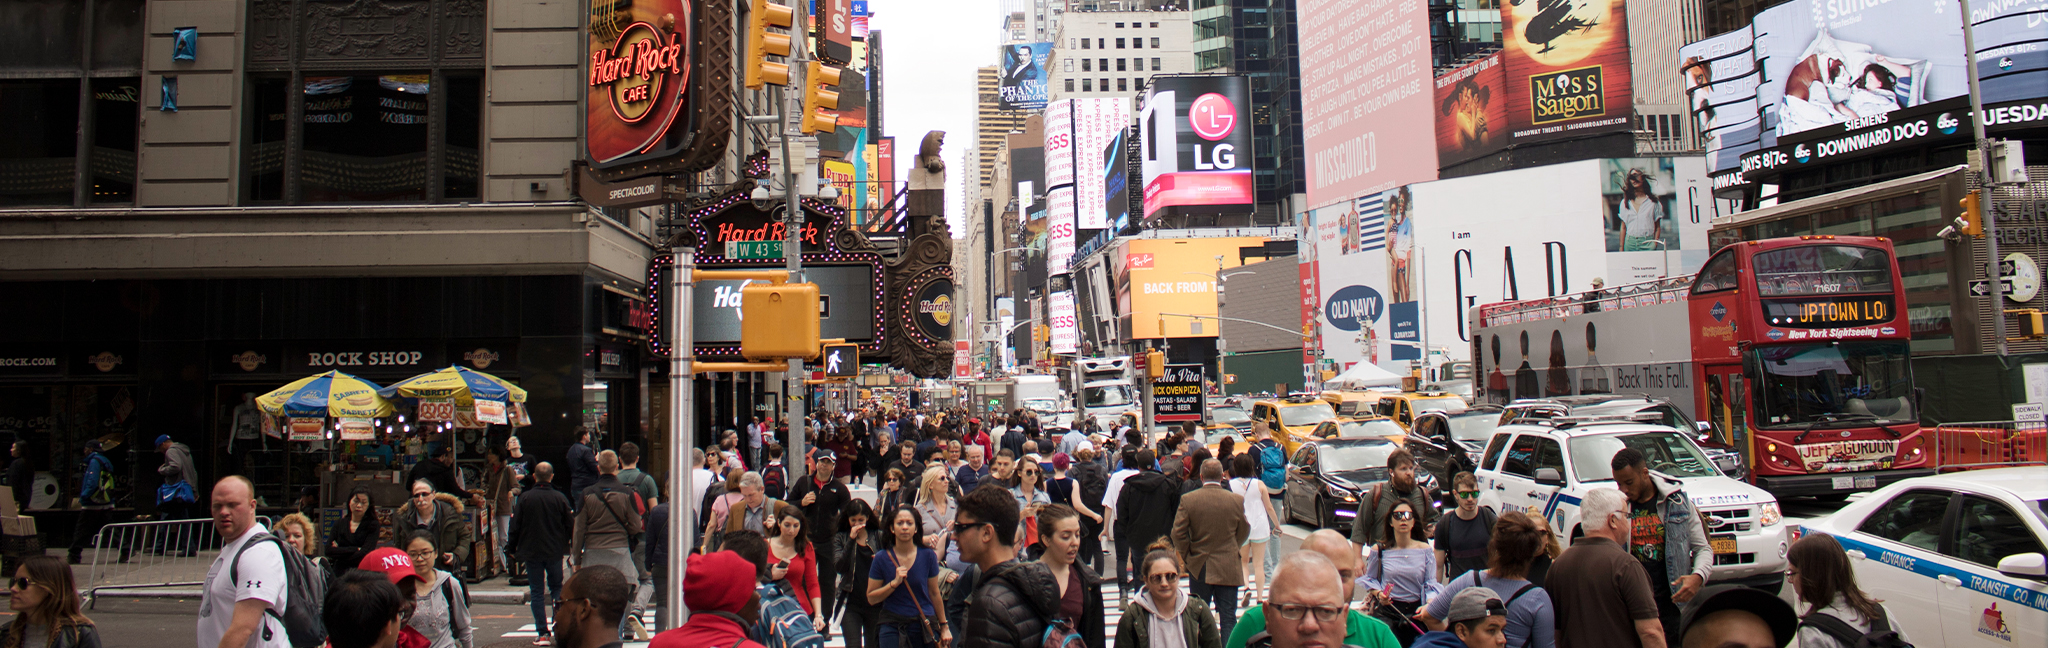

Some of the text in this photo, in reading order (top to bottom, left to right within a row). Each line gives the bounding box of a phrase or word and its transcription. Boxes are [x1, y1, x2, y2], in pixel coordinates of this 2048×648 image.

[1305, 4, 1370, 52] BELIEVE IN HAVE BAD
[1310, 11, 1326, 30] YOUR
[1830, 14, 1862, 30] film festival
[1314, 43, 1334, 64] OTHER
[1338, 33, 1354, 51] LOVE
[1354, 19, 1375, 42] DON'T
[1376, 9, 1394, 30] HATE
[1399, 0, 1418, 18] FREE
[590, 33, 680, 86] Hard Rock
[1312, 20, 1412, 82] STAY UP ALL NIGHT OVERCOME
[1697, 41, 1727, 62] EVER
[1976, 46, 2014, 60] TUESDAYS
[1310, 35, 1422, 102] EAT PIZZA MAKE MISTAKES DO IT
[1452, 71, 1462, 84] LOVE
[1462, 66, 1474, 79] STORY
[1474, 64, 1480, 74] OF
[1480, 60, 1488, 72] OUR
[1488, 54, 1498, 68] TIME
[1711, 56, 1744, 78] WHAT
[622, 84, 648, 104] CAFE
[1316, 59, 1416, 117] LAUGH UNTIL YOU PEE A LITTLE
[1724, 82, 1736, 95] IS
[1328, 80, 1421, 130] OWN IT BE YOUR OWN BABE
[1537, 93, 1600, 118] Saigon
[1514, 117, 1626, 138] BROADWAY THEATRE SAIGONBROADWAY.COM
[1844, 112, 1888, 132] SIEMENS
[1817, 127, 1892, 158] DOWNWARD
[1894, 120, 1928, 141] DOG
[1194, 143, 1236, 170] LG
[1315, 131, 1377, 190] MISSGUIDED
[826, 168, 855, 188] BUBBA
[610, 184, 655, 200] SPECTACOLOR
[718, 222, 768, 242] Hard
[1452, 231, 1471, 240] I am
[739, 242, 782, 257] W 43 St
[1144, 282, 1208, 294] BACK FROM
[1814, 284, 1841, 292] 71607
[920, 301, 944, 314] Hard
[1331, 296, 1377, 320] OLD NAVY
[1800, 302, 1858, 323] UPTOWN
[1788, 326, 1878, 339] New York Sightseeing
[308, 352, 422, 366] ROCK SHOP
[464, 352, 500, 362] Hard Rock
[1178, 368, 1201, 383] Vita
[1618, 362, 1688, 389] Back This Fall.
[334, 390, 370, 401] SABRETT
[1166, 385, 1202, 396] OVEN PIZZA
[1803, 442, 1894, 458] JEFF GORDON
[1538, 492, 1550, 502] CUNY
[1710, 494, 1750, 504] SAFETY
[382, 554, 411, 570] NYC
[1880, 551, 1916, 571] ADVANCE
[1970, 575, 2010, 598] TRANSIT
[1978, 627, 2012, 642] ACCESS-A-RIDE
